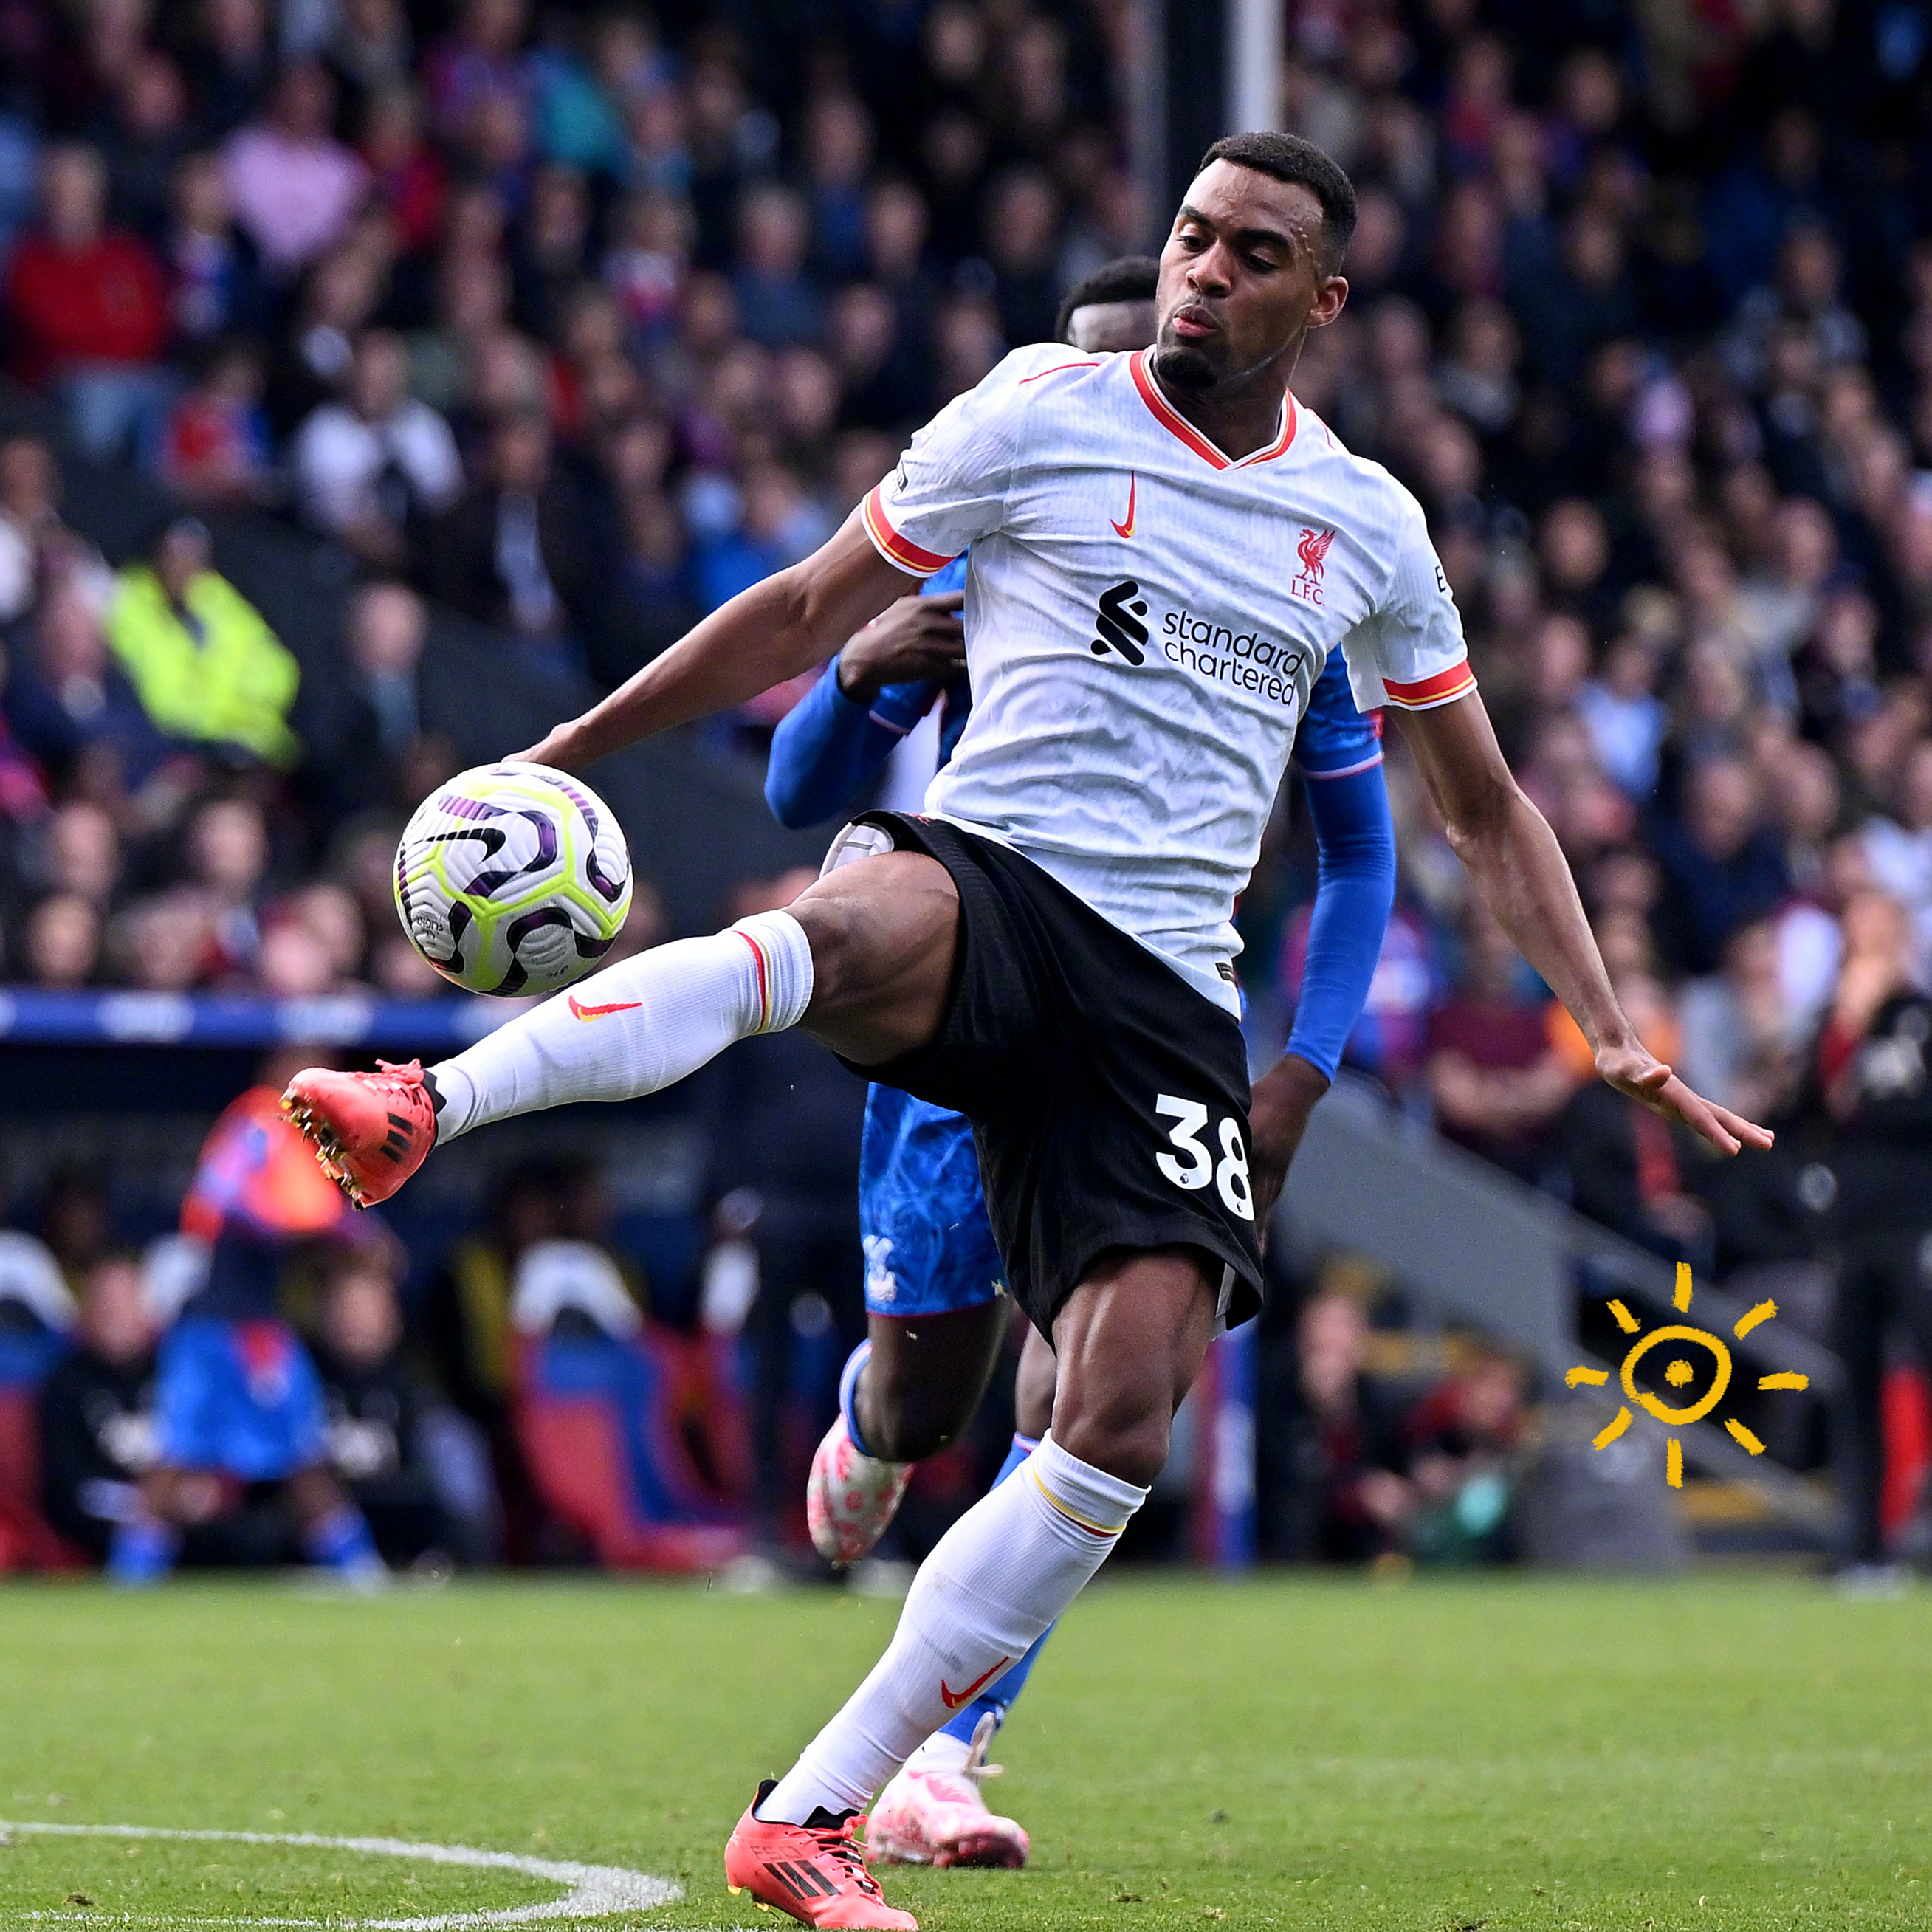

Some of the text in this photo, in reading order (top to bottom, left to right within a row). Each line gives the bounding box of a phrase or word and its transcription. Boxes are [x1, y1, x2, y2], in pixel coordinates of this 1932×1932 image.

[1162, 610, 1306, 677] standard
[1164, 641, 1296, 707] chartered
[1155, 1093, 1255, 1221] 38
